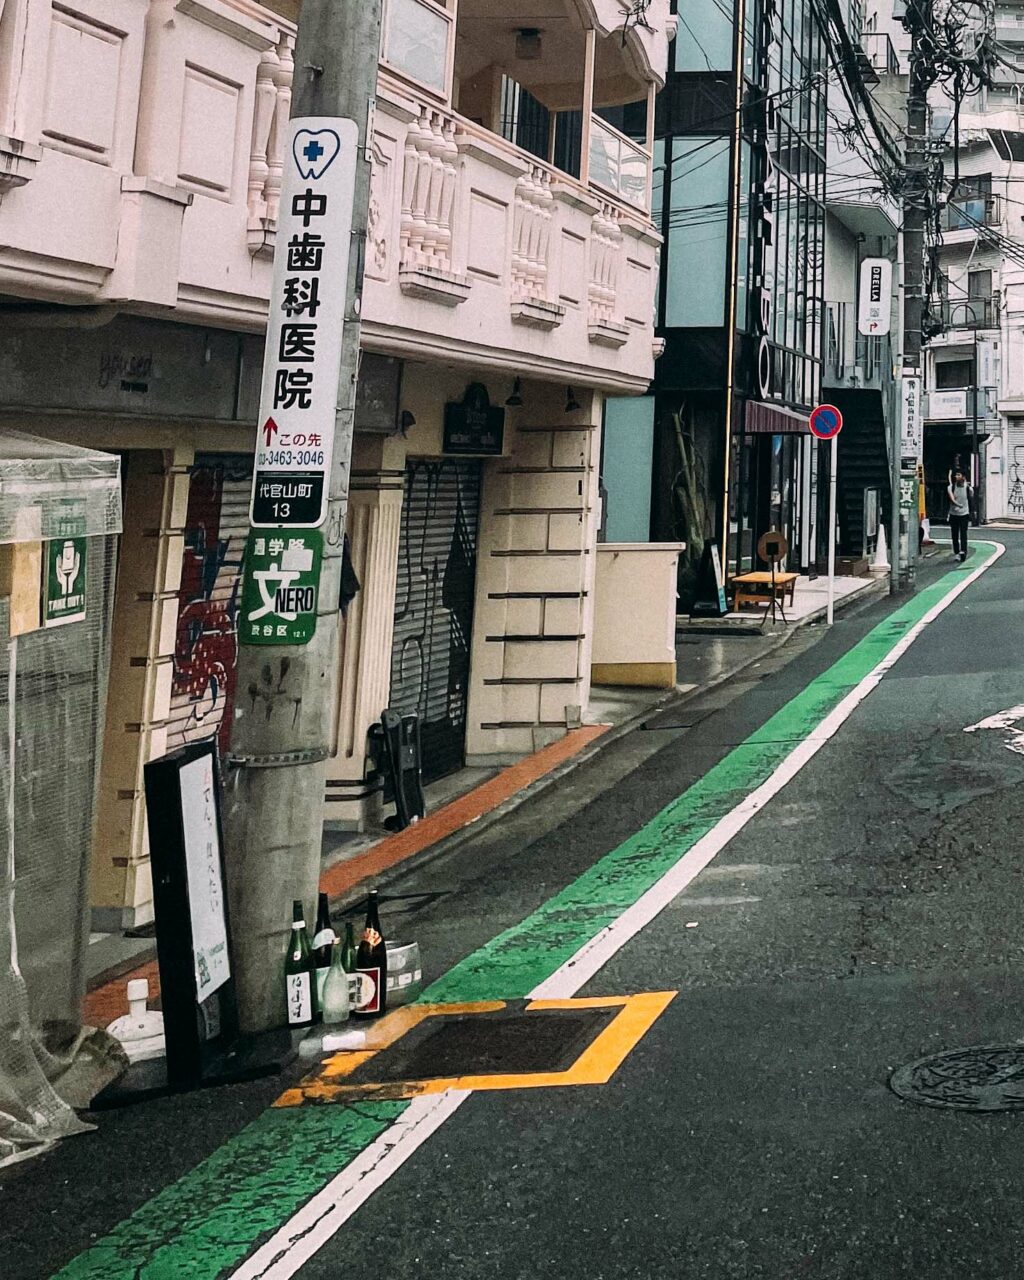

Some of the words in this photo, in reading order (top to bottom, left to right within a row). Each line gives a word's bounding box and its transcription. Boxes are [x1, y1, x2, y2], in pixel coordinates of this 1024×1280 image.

[871, 267, 881, 301] DRELLA
[273, 188, 327, 410] 中歯科医院
[279, 433, 322, 447] この先
[258, 450, 324, 466] 03-3463-3046
[260, 483, 314, 498] 代官山町
[272, 503, 291, 518] 13
[247, 562, 301, 622] 文
[274, 586, 315, 613] NERO
